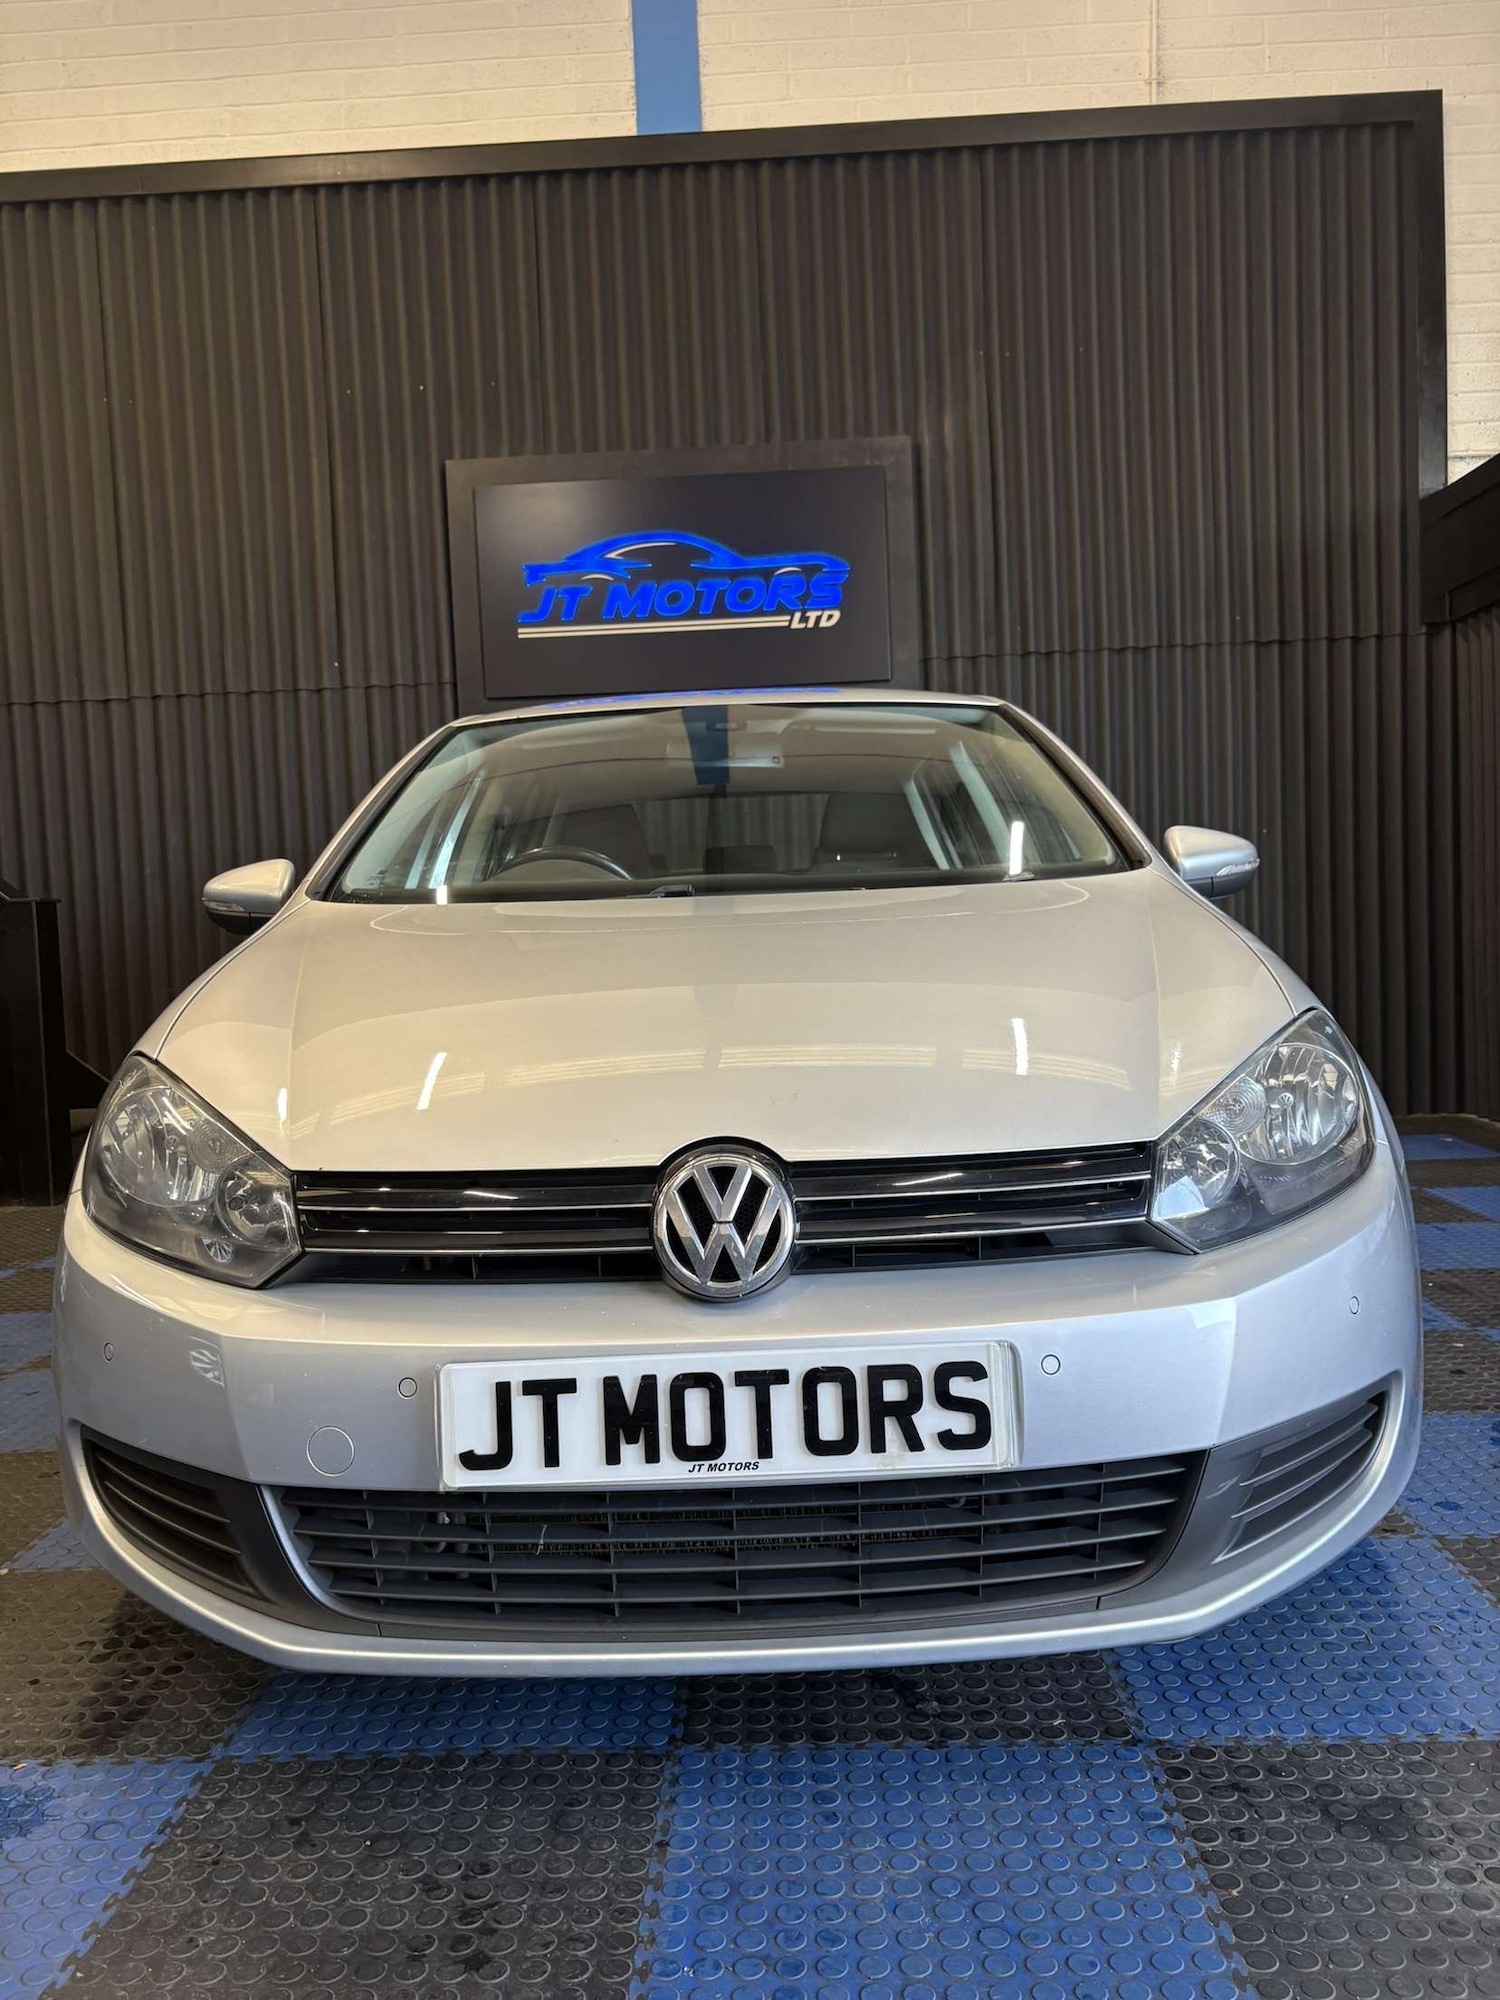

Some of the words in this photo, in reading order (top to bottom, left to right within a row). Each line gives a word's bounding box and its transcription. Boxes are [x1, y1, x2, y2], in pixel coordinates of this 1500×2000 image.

[518, 586, 593, 623] JT
[603, 572, 849, 619] MOTORS
[790, 609, 841, 629] LTD
[458, 1378, 577, 1471] JT
[602, 1361, 992, 1466] MOTORS
[688, 1463, 705, 1473] JT
[707, 1461, 760, 1472] MOTORS
